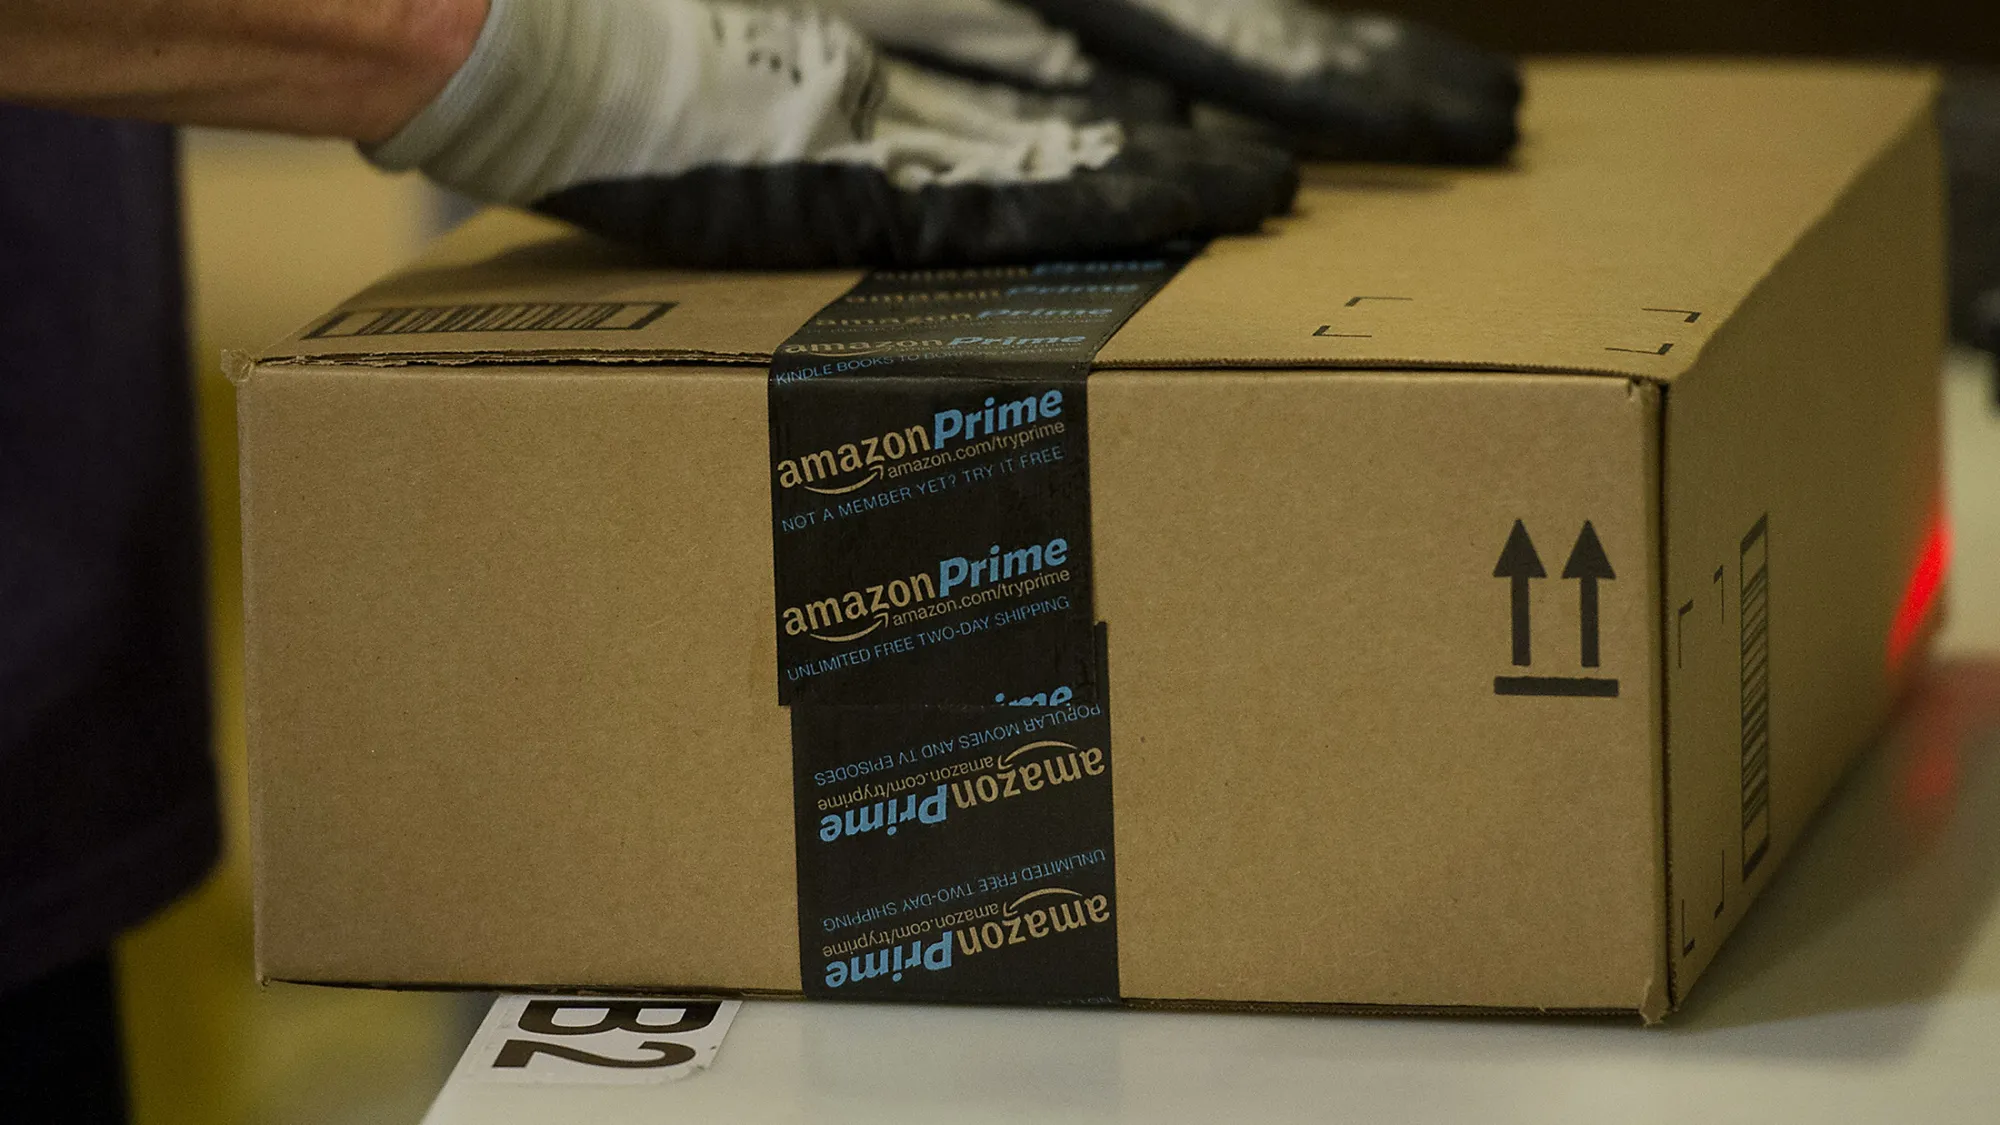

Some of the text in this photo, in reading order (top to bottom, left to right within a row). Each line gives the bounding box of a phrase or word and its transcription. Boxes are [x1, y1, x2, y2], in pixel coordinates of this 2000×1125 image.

[776, 364, 832, 385] KINDLE
[836, 356, 893, 372] BOOKS
[887, 420, 1065, 479] amazon.com/tryprime
[781, 445, 1065, 533] NOT A MEMBER YET? TRY IT FREE
[892, 568, 1070, 627] amazon.com/tryprime
[786, 595, 1070, 681] UNLIMITED FREE TWO-DAY SHIPPING
[813, 703, 1101, 786] POPULAR MOVIES AND TV EPISODES
[817, 755, 994, 811] amazon.com/tryprime
[823, 848, 1106, 932] UNLIMITED FREE TWO-DAY SHIPPING
[823, 903, 999, 957] amazon.com/tryprime
[492, 1000, 723, 1068] B2
